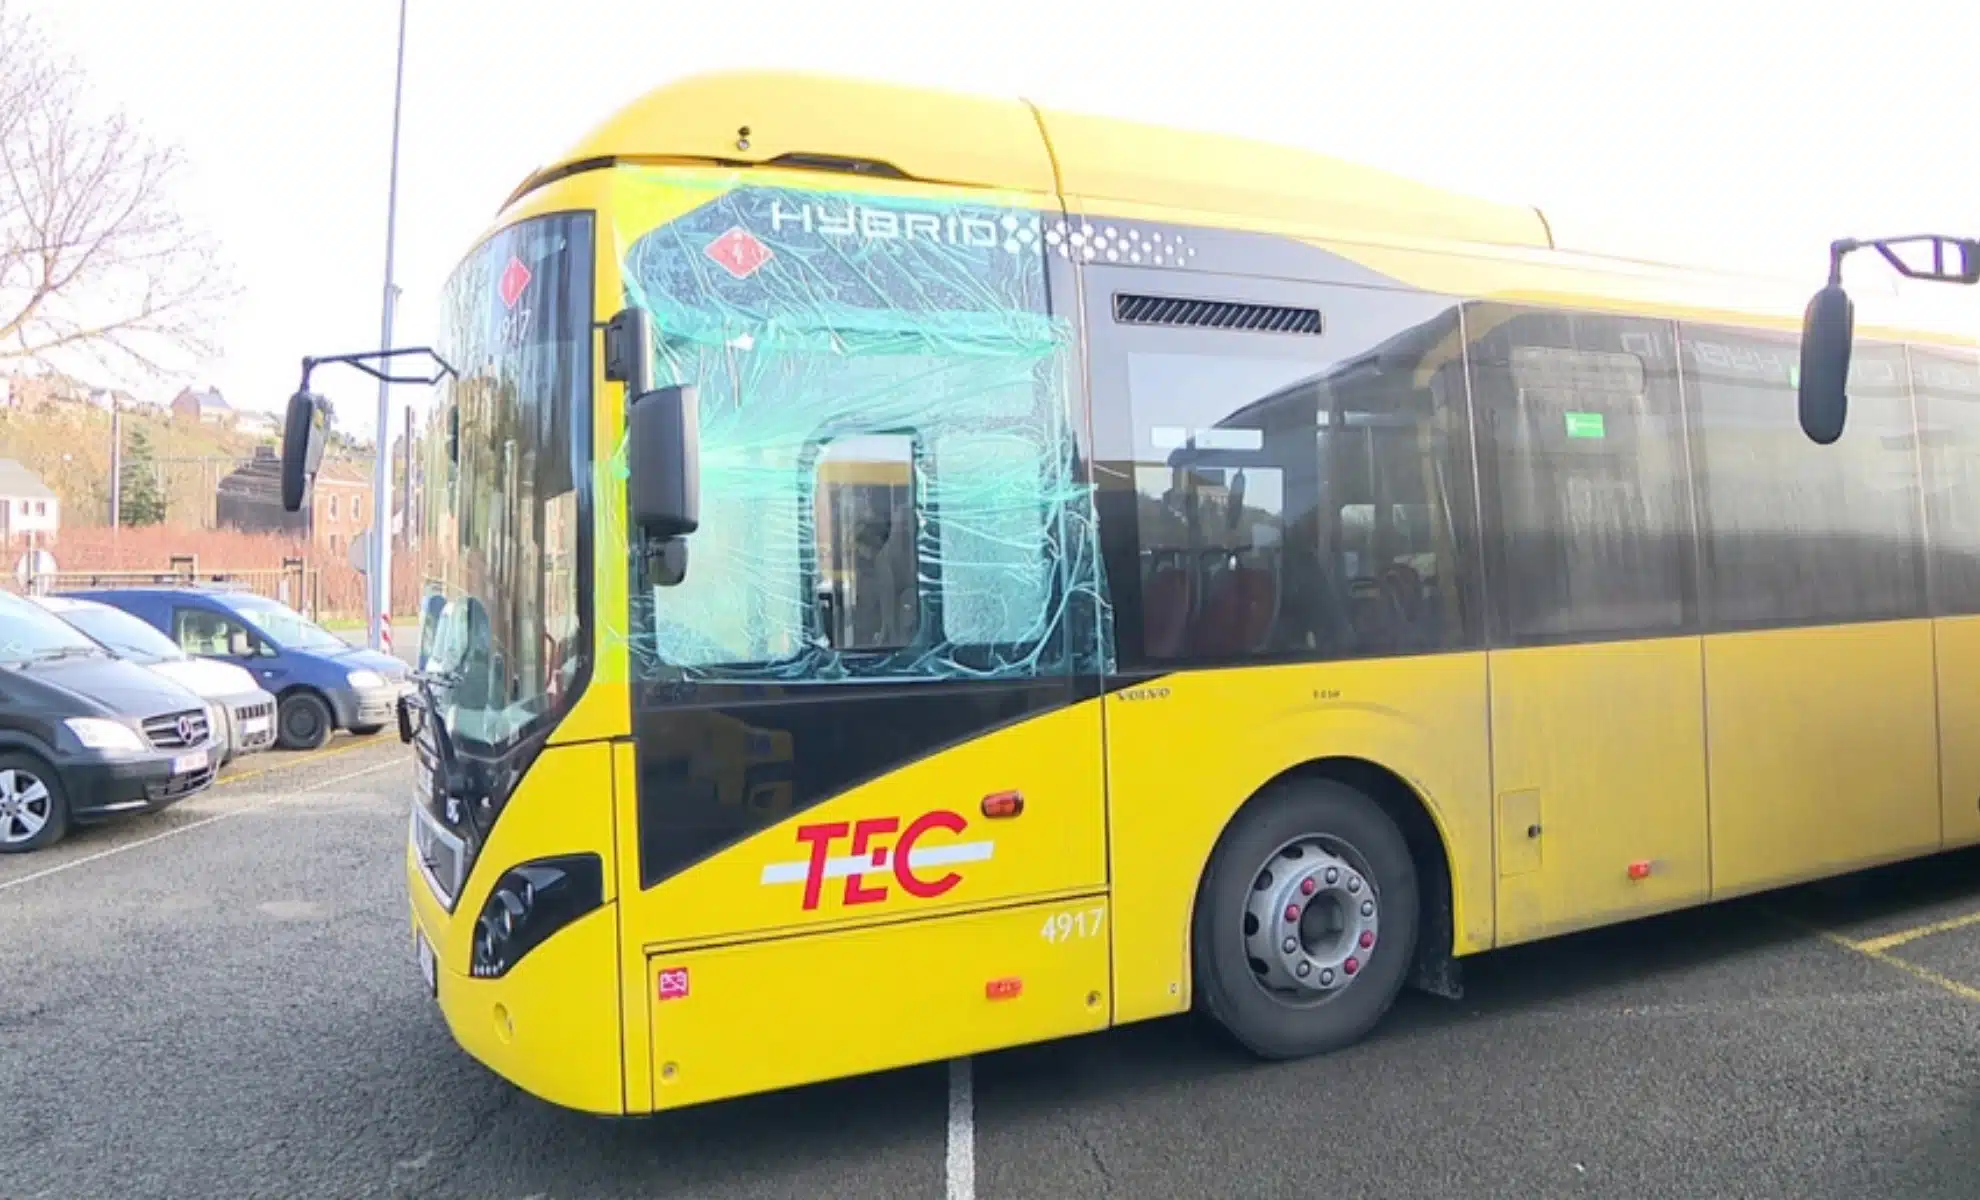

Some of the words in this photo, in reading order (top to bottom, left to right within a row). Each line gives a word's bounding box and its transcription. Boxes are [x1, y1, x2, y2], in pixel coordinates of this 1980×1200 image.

[771, 200, 997, 248] HYBRID
[796, 810, 968, 911] TEC
[1040, 908, 1104, 944] 4917
